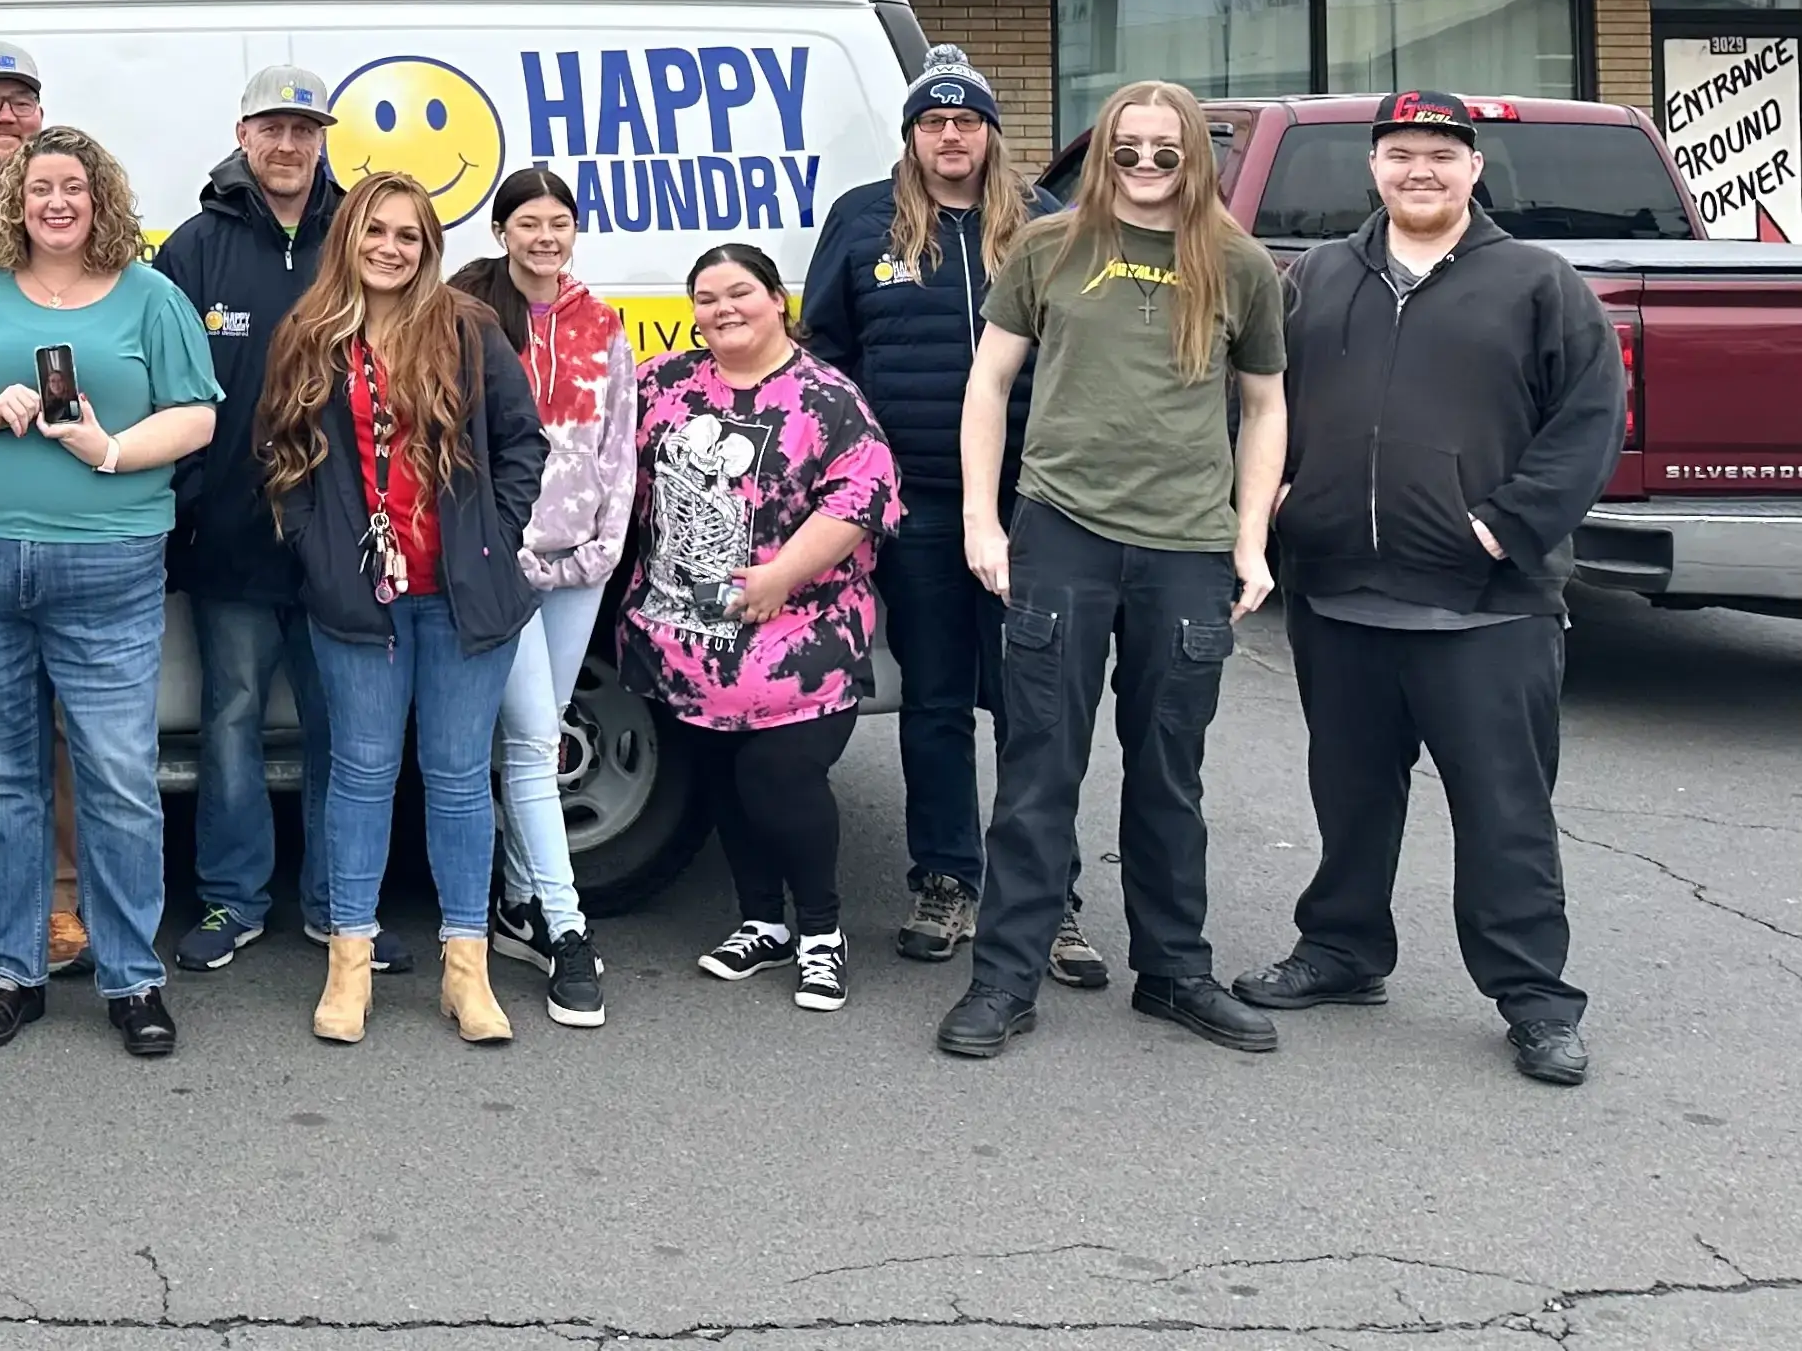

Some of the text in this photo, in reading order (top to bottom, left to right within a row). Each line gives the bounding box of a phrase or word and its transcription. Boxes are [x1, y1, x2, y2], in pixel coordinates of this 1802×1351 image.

[1711, 36, 1745, 53] 3029
[521, 46, 809, 157] HAPPY
[1666, 37, 1795, 133] ENTRANCE
[1674, 98, 1782, 179] AROUND
[532, 155, 821, 234] AUNDRY
[1690, 149, 1796, 223] ORNER
[1080, 257, 1184, 295] METALLIC
[1665, 465, 1802, 479] SILVERAD
